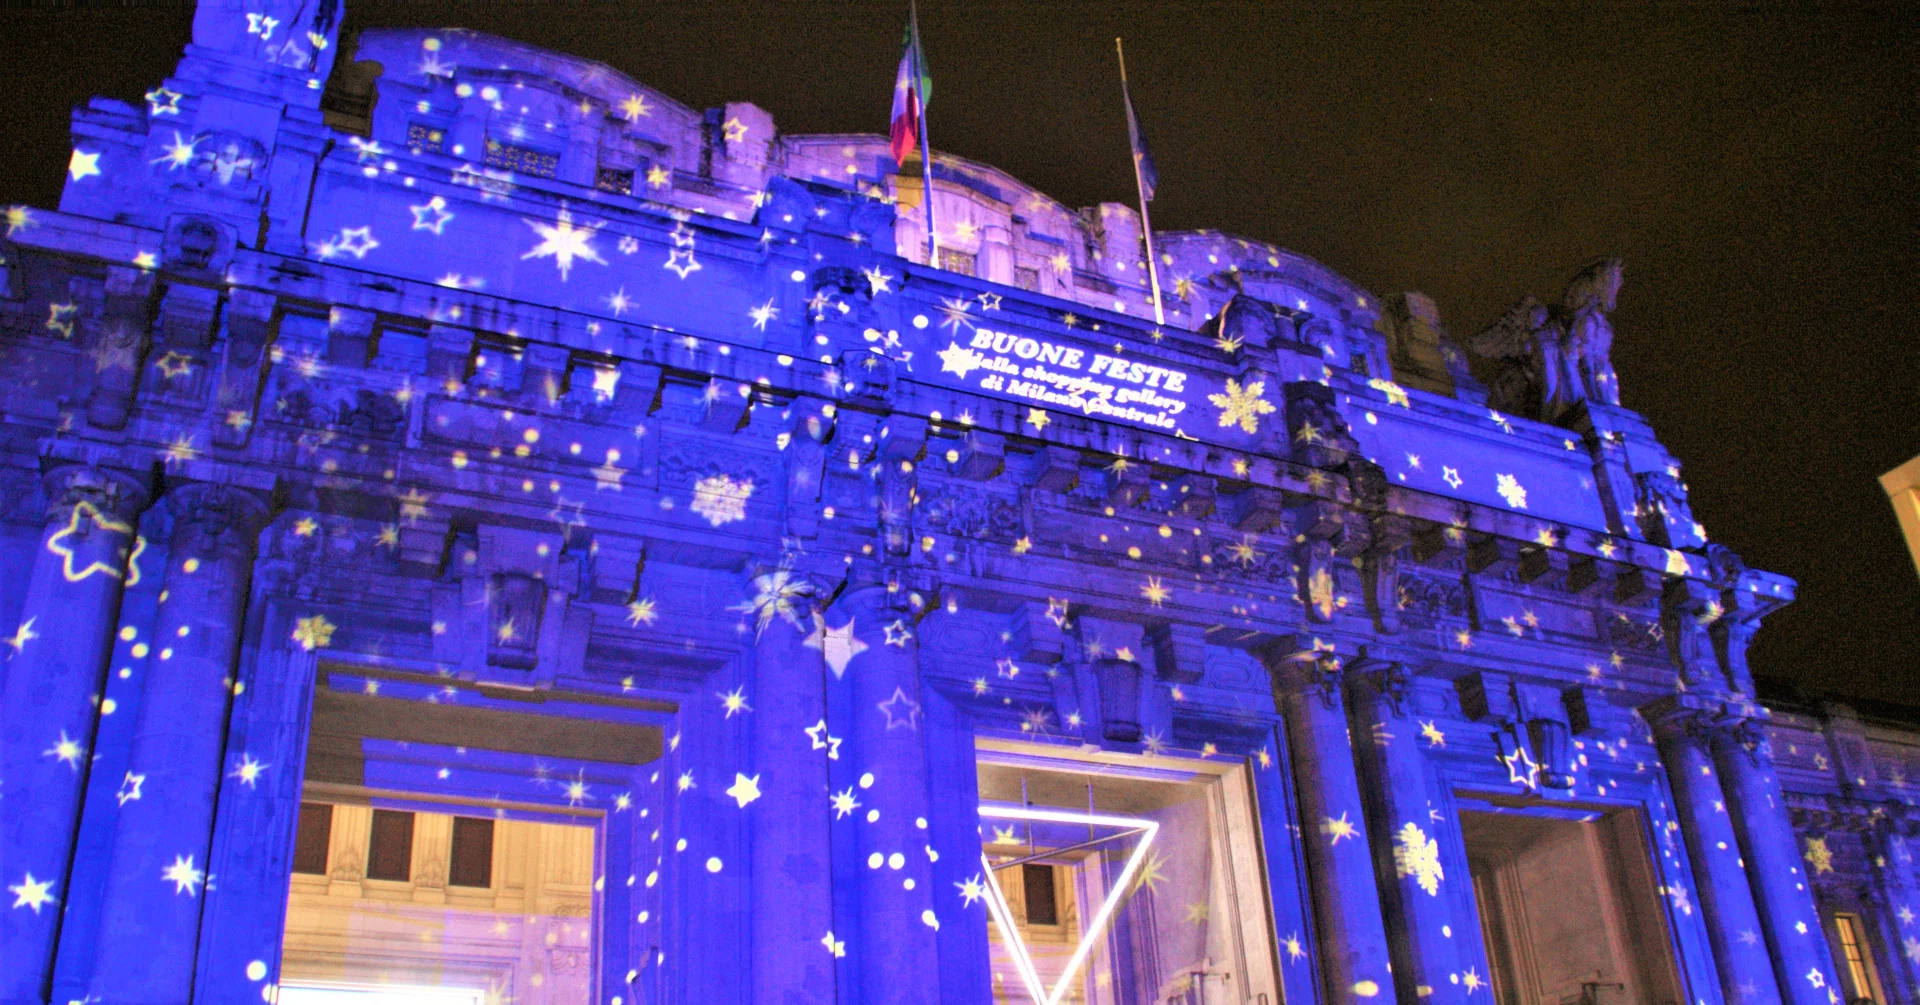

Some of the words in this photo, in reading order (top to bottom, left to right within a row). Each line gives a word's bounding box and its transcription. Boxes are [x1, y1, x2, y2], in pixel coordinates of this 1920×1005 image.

[970, 328, 1084, 369] BUONE
[1088, 354, 1187, 392] FESTE
[980, 375, 1004, 391] di
[1006, 379, 1083, 408] Milano
[1115, 388, 1186, 414] gallery
